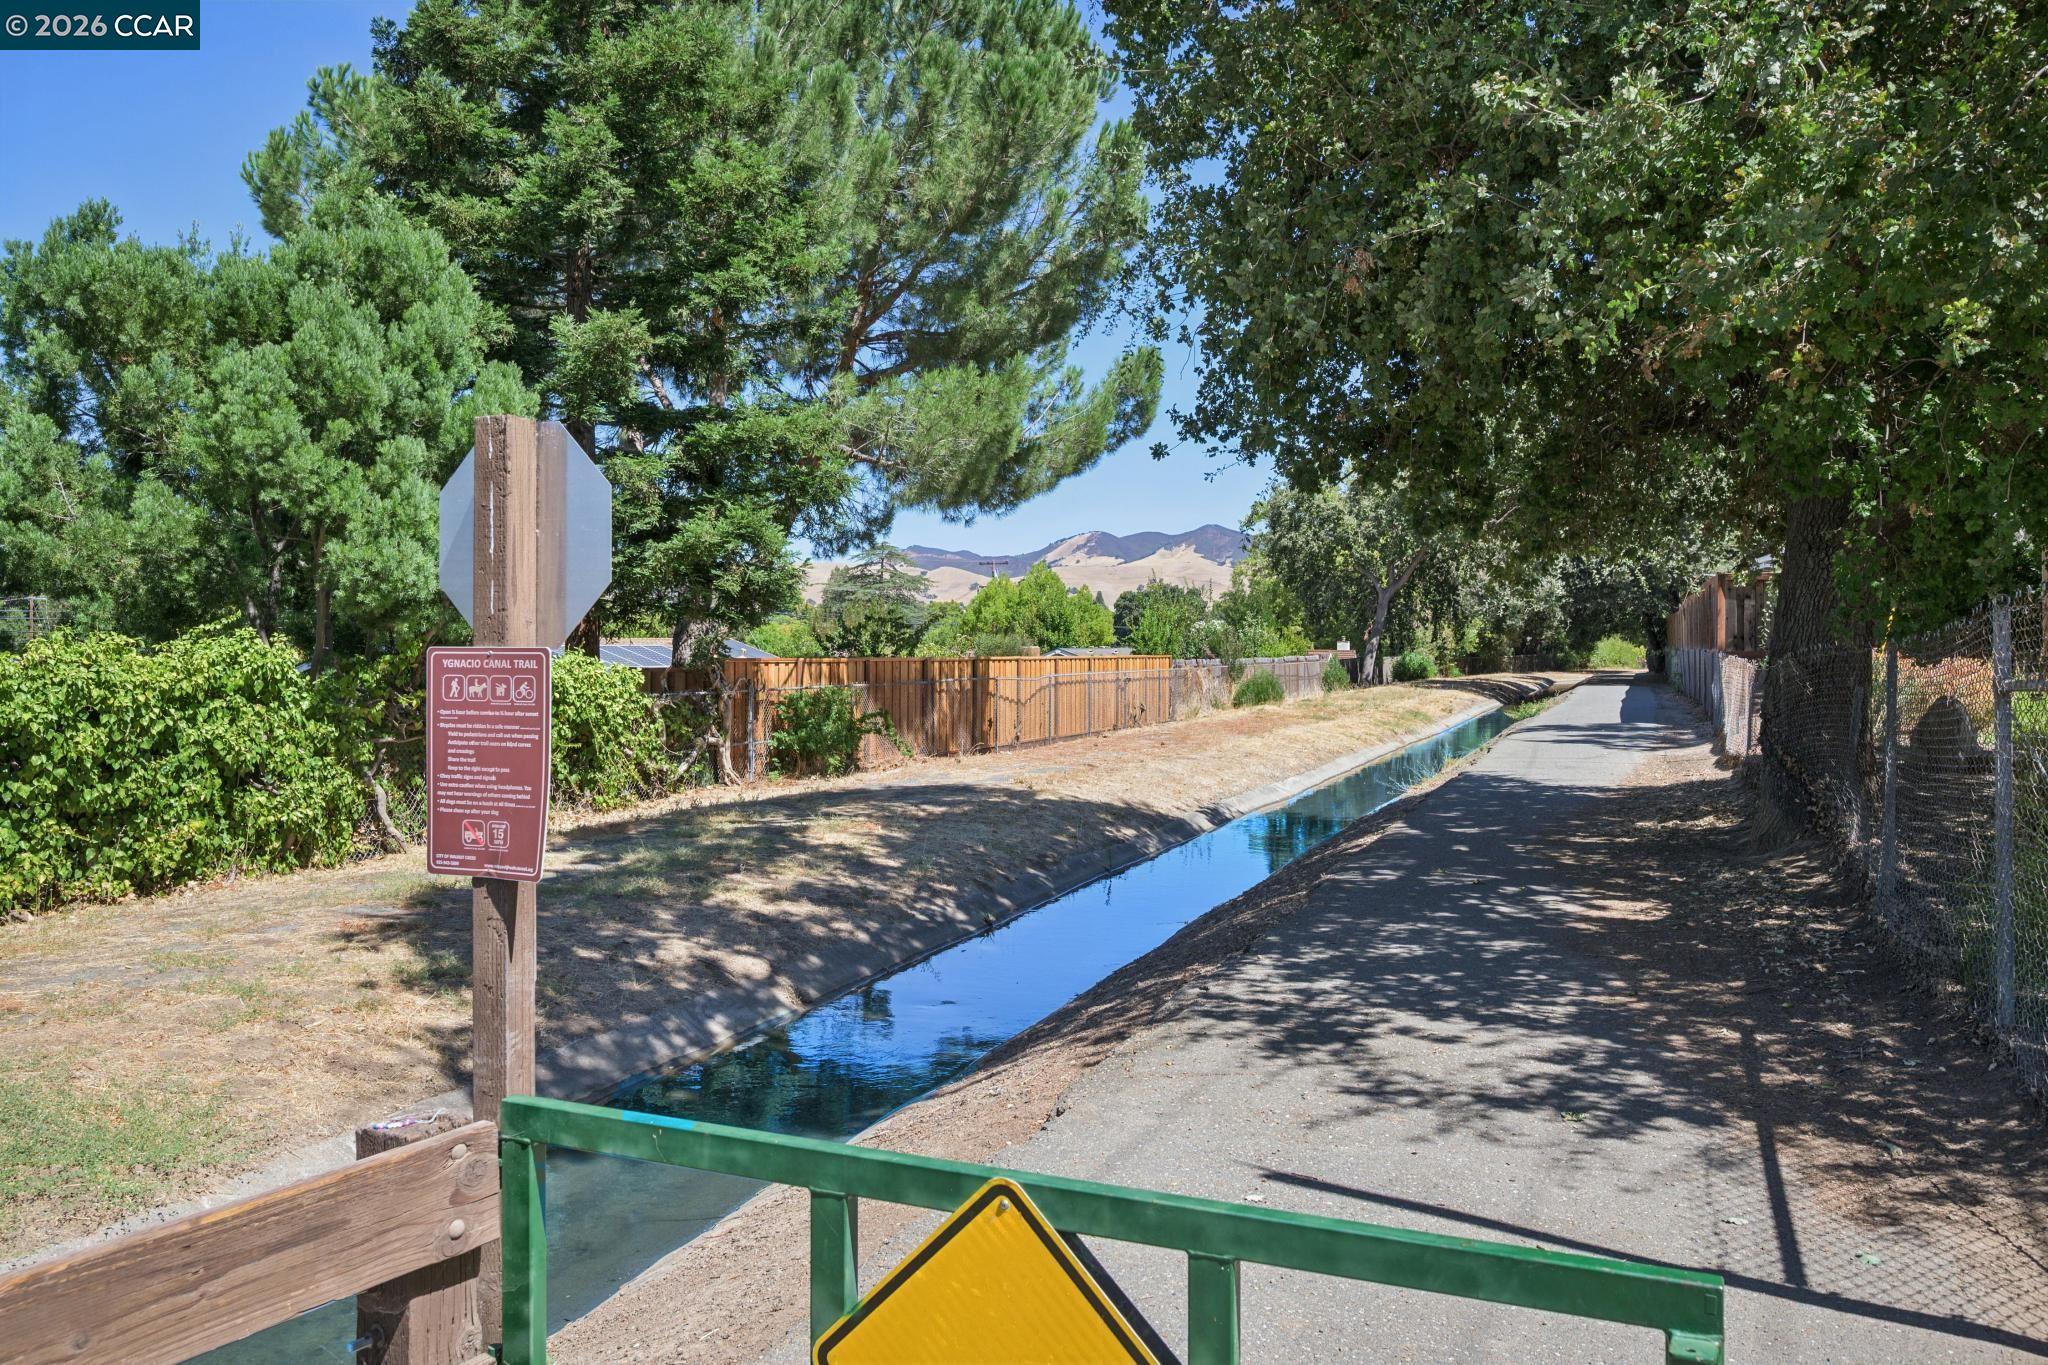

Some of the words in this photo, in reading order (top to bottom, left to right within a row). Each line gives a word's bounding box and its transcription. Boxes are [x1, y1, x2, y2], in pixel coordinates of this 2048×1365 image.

[442, 658, 481, 669] YGNACIO
[483, 659, 512, 669] CANAL
[513, 659, 538, 669] TRAIL
[493, 828, 505, 840] 15
